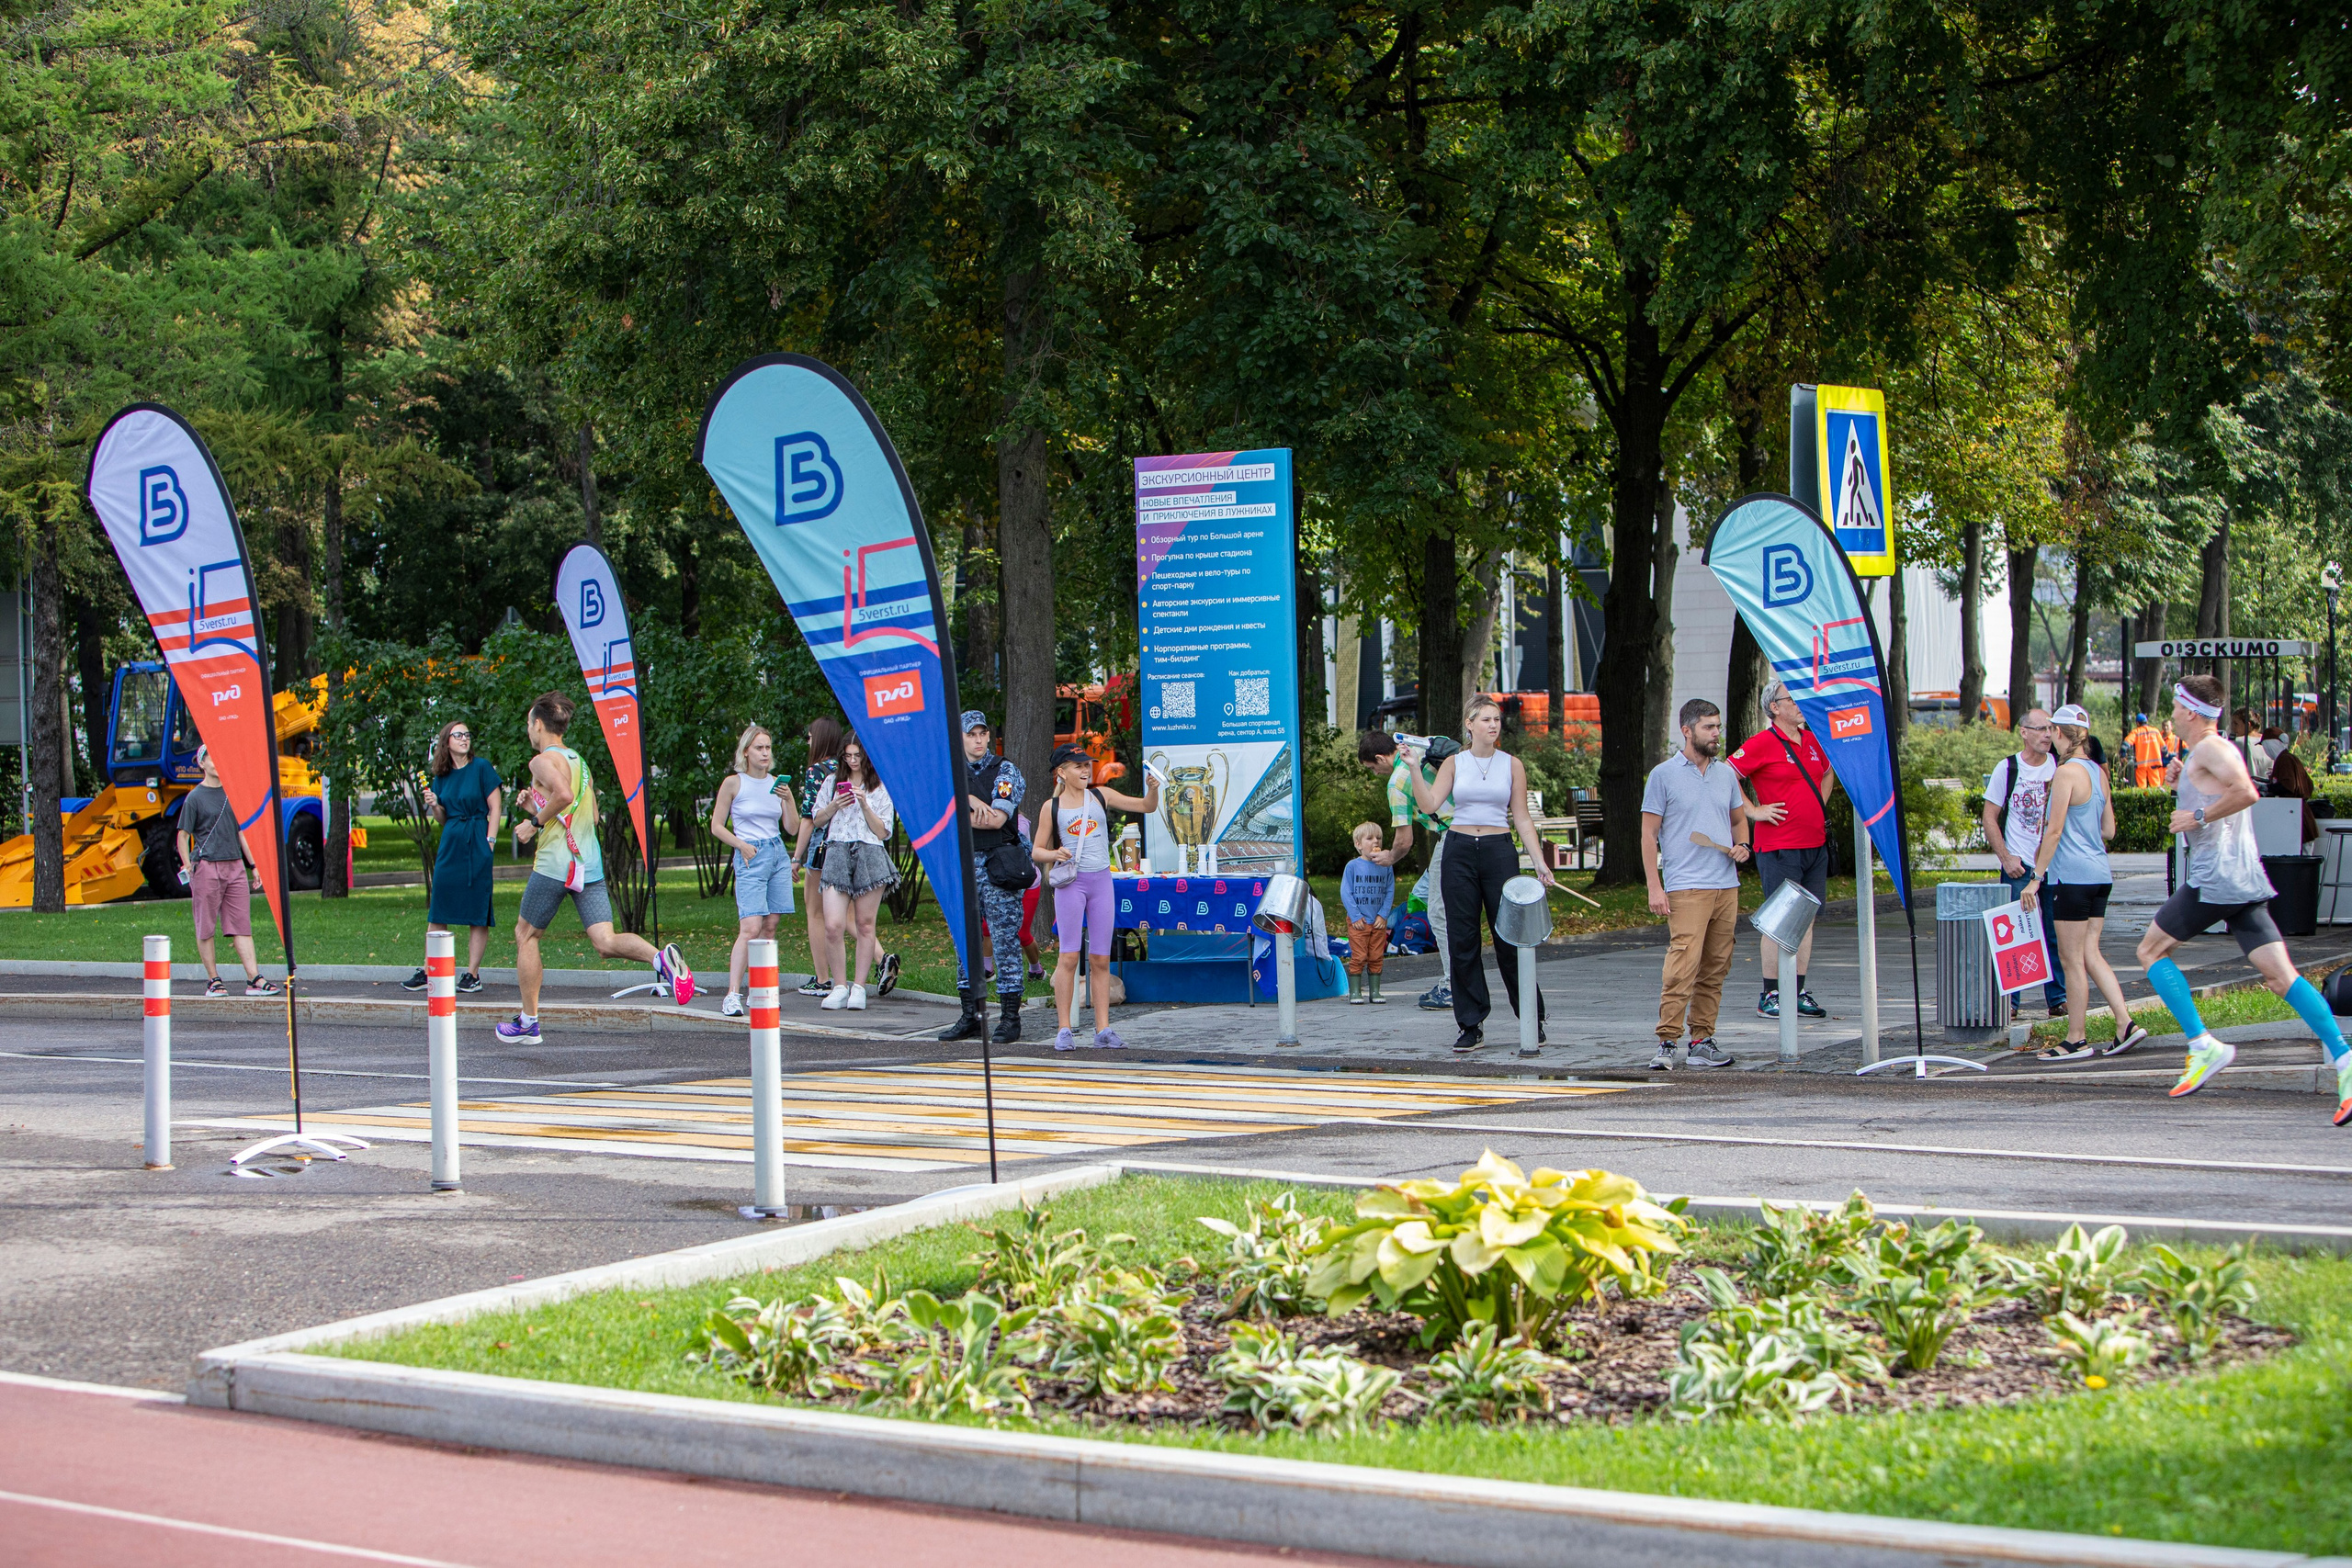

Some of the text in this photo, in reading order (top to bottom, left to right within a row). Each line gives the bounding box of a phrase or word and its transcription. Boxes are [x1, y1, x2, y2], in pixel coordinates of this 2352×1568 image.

[1142, 468, 1271, 486] ЭКСКУРСИОННЫЙ ЦЕНТР
[1142, 494, 1233, 508] НОВЫЕ ВПЕЧАТЛЕНИЯ
[1153, 509, 1216, 521] ПРИКЛЮЧЕНИЯ
[1225, 505, 1272, 516] ЛУЖНИКАХ
[1150, 535, 1186, 544] Обзорный
[1187, 535, 1198, 543] тур
[1210, 531, 1242, 540] Большой
[1243, 531, 1264, 539] арене
[1151, 553, 1184, 562] Прогулка
[1195, 551, 1219, 560] крыше
[1220, 549, 1252, 558] стадиона
[1151, 570, 1197, 580] Пешеходные
[1204, 569, 1240, 577] вело-туры
[1151, 581, 1195, 592] спорт-парку
[1152, 599, 1189, 608] Авторские
[1190, 597, 1225, 606] экскурсии
[1232, 594, 1281, 604] иммерсивные
[858, 604, 910, 622] 5verst.ru
[1152, 610, 1189, 618] спектакли
[199, 616, 237, 631] 5verst.ru
[1153, 626, 1182, 636] Детские
[1198, 624, 1234, 633] рождения
[1154, 642, 1251, 654] Корпоративные программы,
[1154, 655, 1200, 663] тим-билдинг
[1240, 669, 1271, 677] добраться:
[1823, 661, 1860, 674] 5verst.ru
[1248, 719, 1281, 728] спортивная
